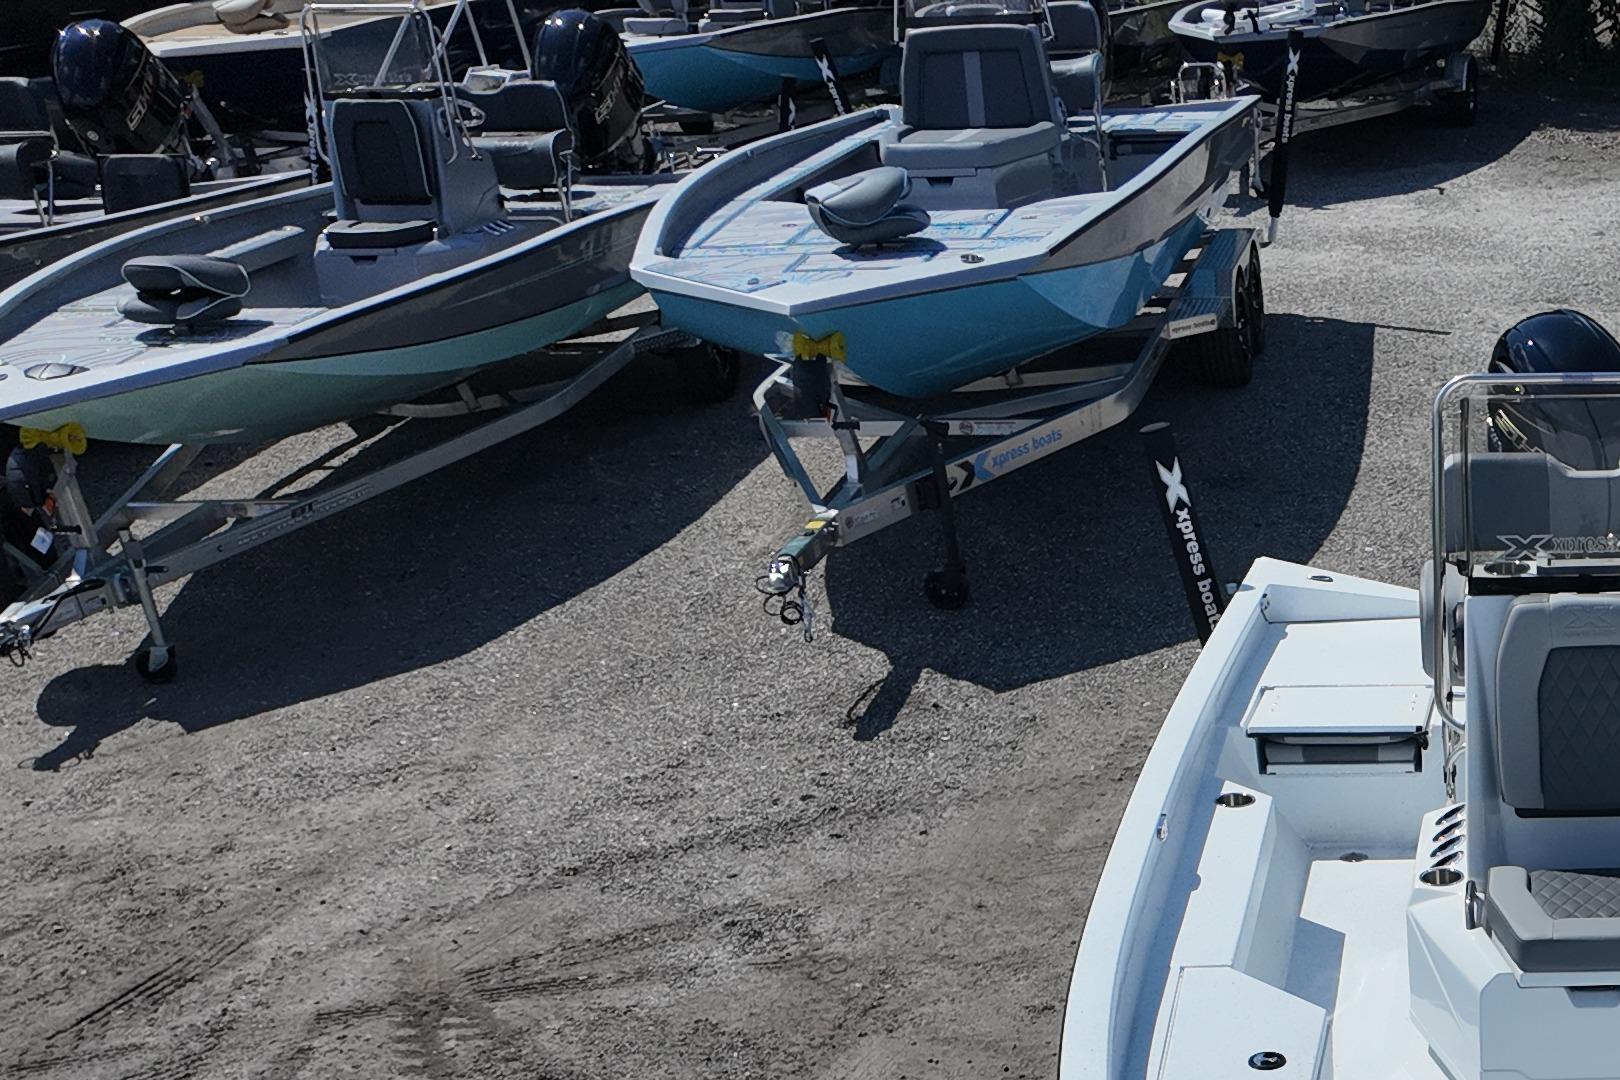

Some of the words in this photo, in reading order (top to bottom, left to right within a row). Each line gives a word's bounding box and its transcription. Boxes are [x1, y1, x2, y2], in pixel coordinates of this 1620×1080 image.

[991, 442, 1031, 468] xpress
[1031, 428, 1064, 450] boats
[1176, 507, 1206, 576] xpress
[1197, 578, 1222, 632] boat
